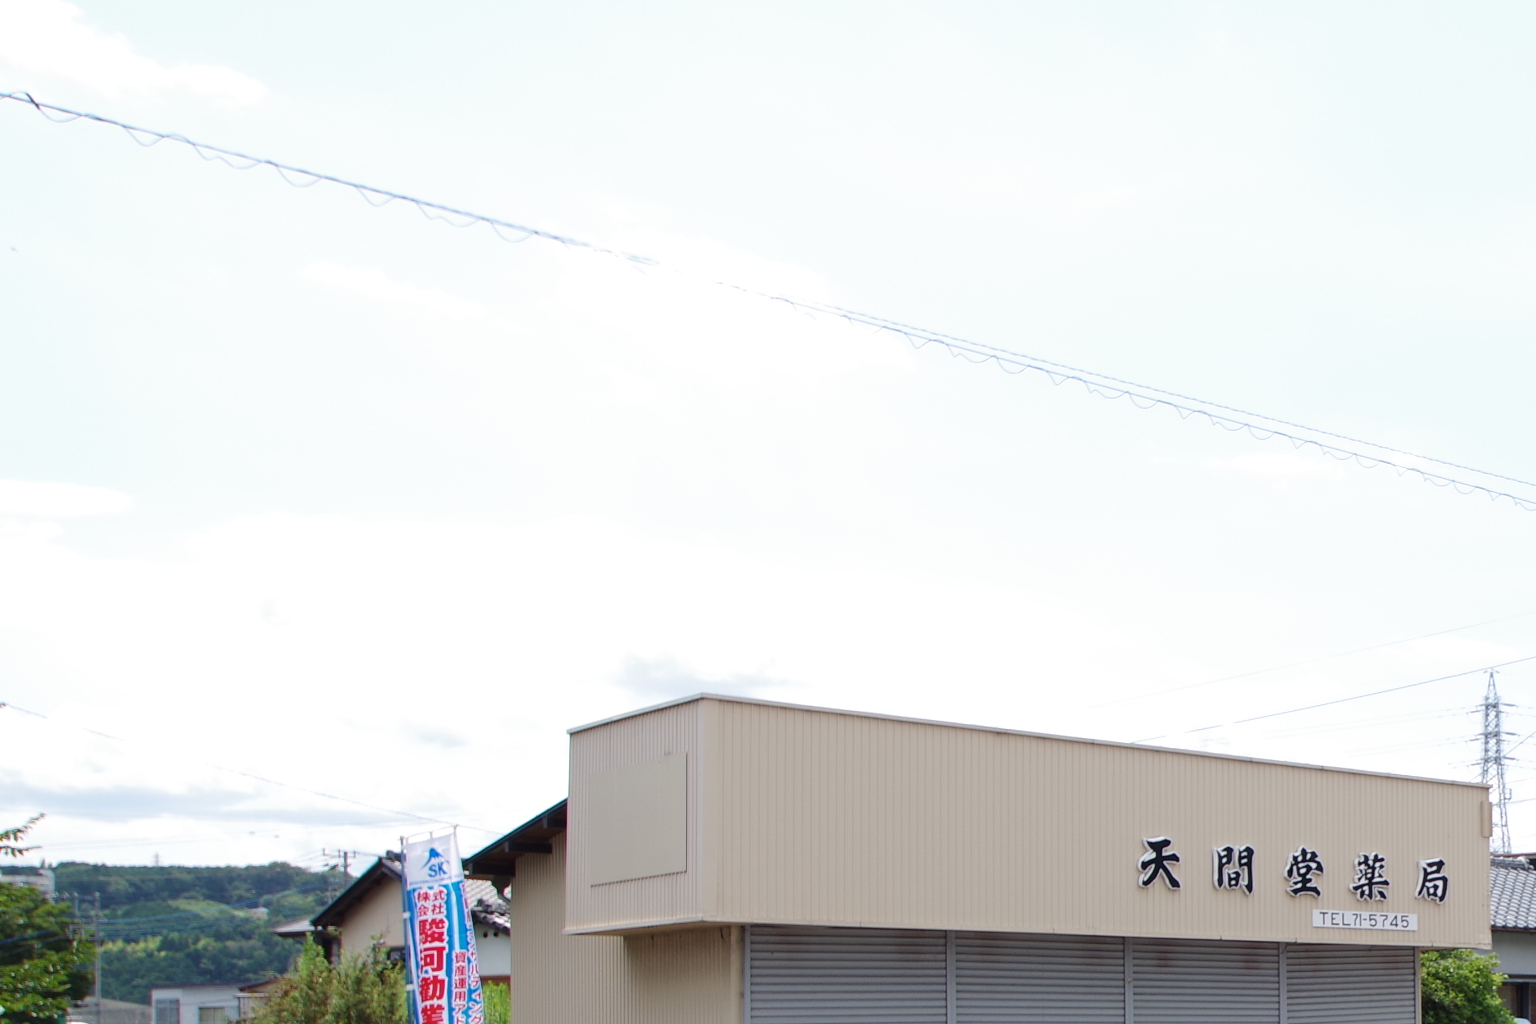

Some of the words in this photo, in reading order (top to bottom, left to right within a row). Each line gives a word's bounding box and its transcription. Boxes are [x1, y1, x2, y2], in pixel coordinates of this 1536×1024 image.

[428, 862, 448, 877] SK
[1138, 837, 1449, 903] 天間堂薬局
